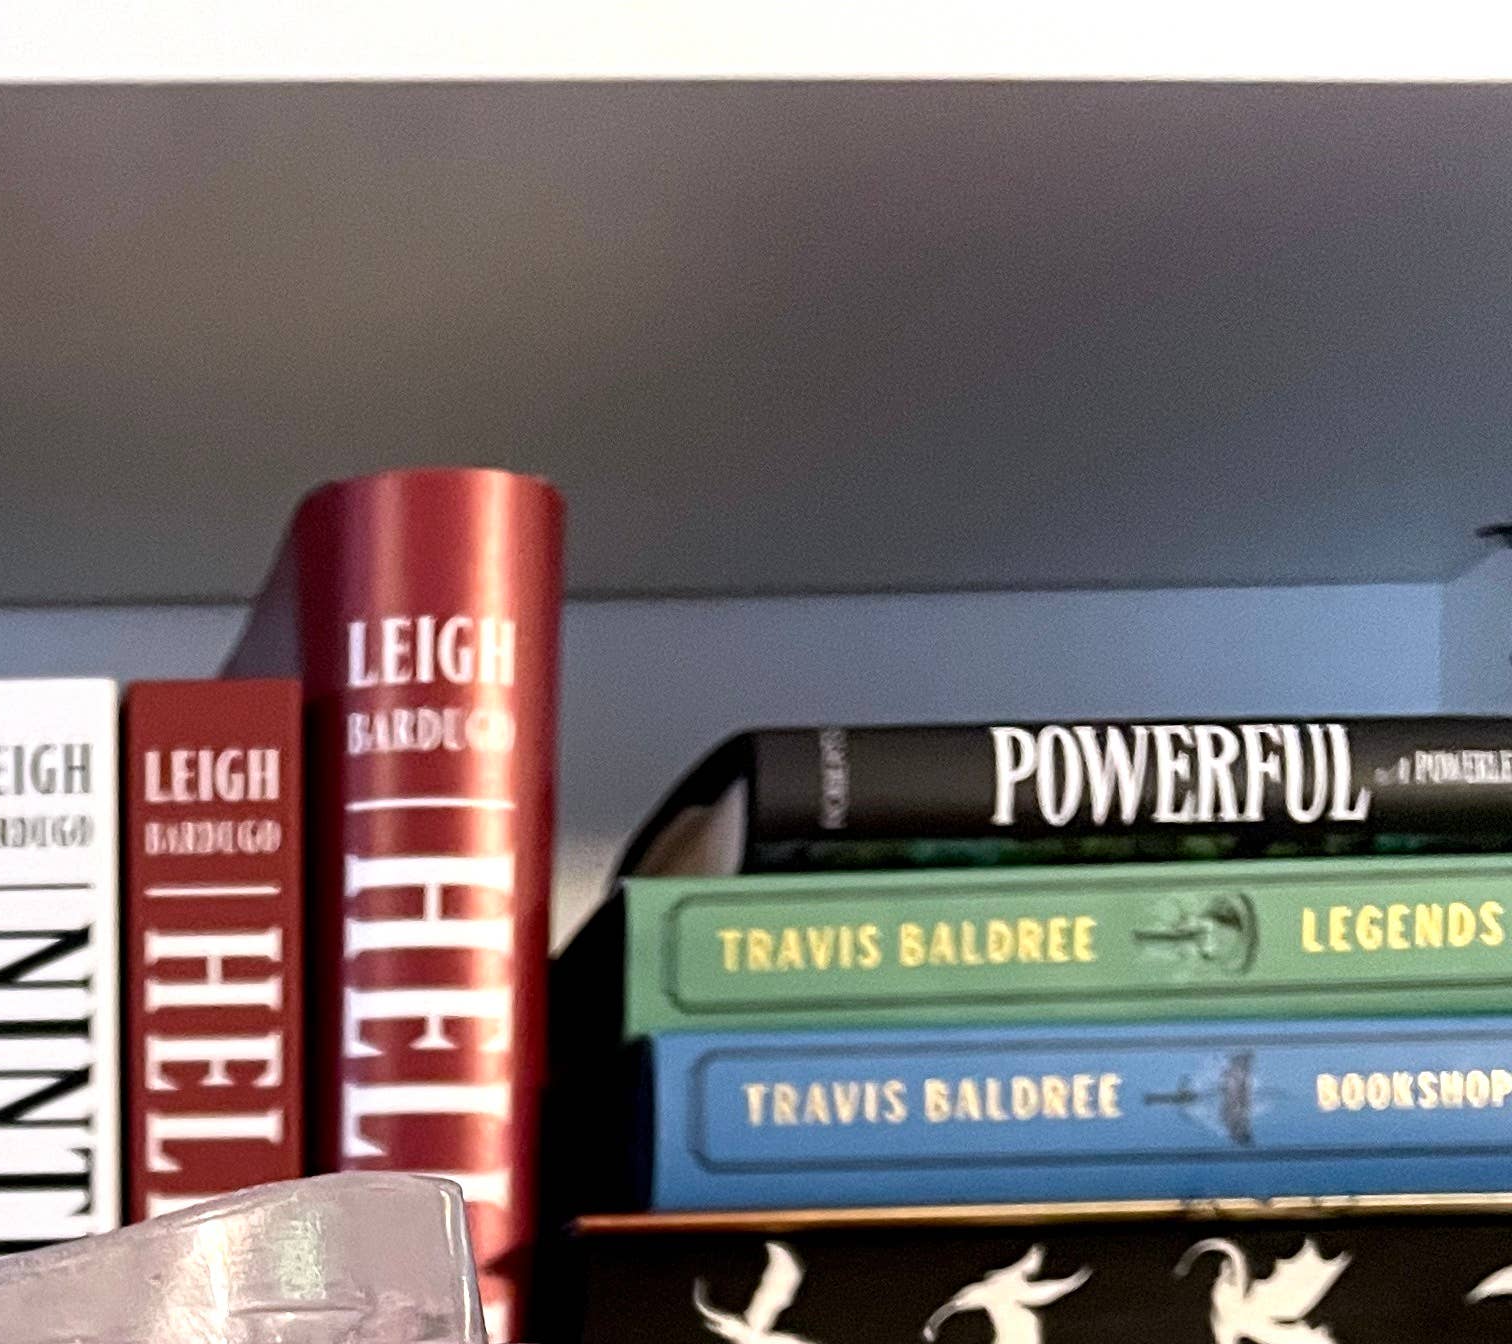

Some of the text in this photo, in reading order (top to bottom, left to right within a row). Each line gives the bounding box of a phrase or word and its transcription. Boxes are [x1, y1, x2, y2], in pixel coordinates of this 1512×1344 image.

[348, 616, 516, 687] LEIGH
[348, 708, 515, 755] BARDUGO
[144, 748, 281, 802] LEIGH
[990, 722, 1372, 827] POWERFUL
[144, 820, 281, 855] BARDUGO
[716, 900, 1506, 974] TRAVIS BALDREE LEGENDS
[742, 1068, 1512, 1127] TRAVIS BALDREE BOOKSHOP
